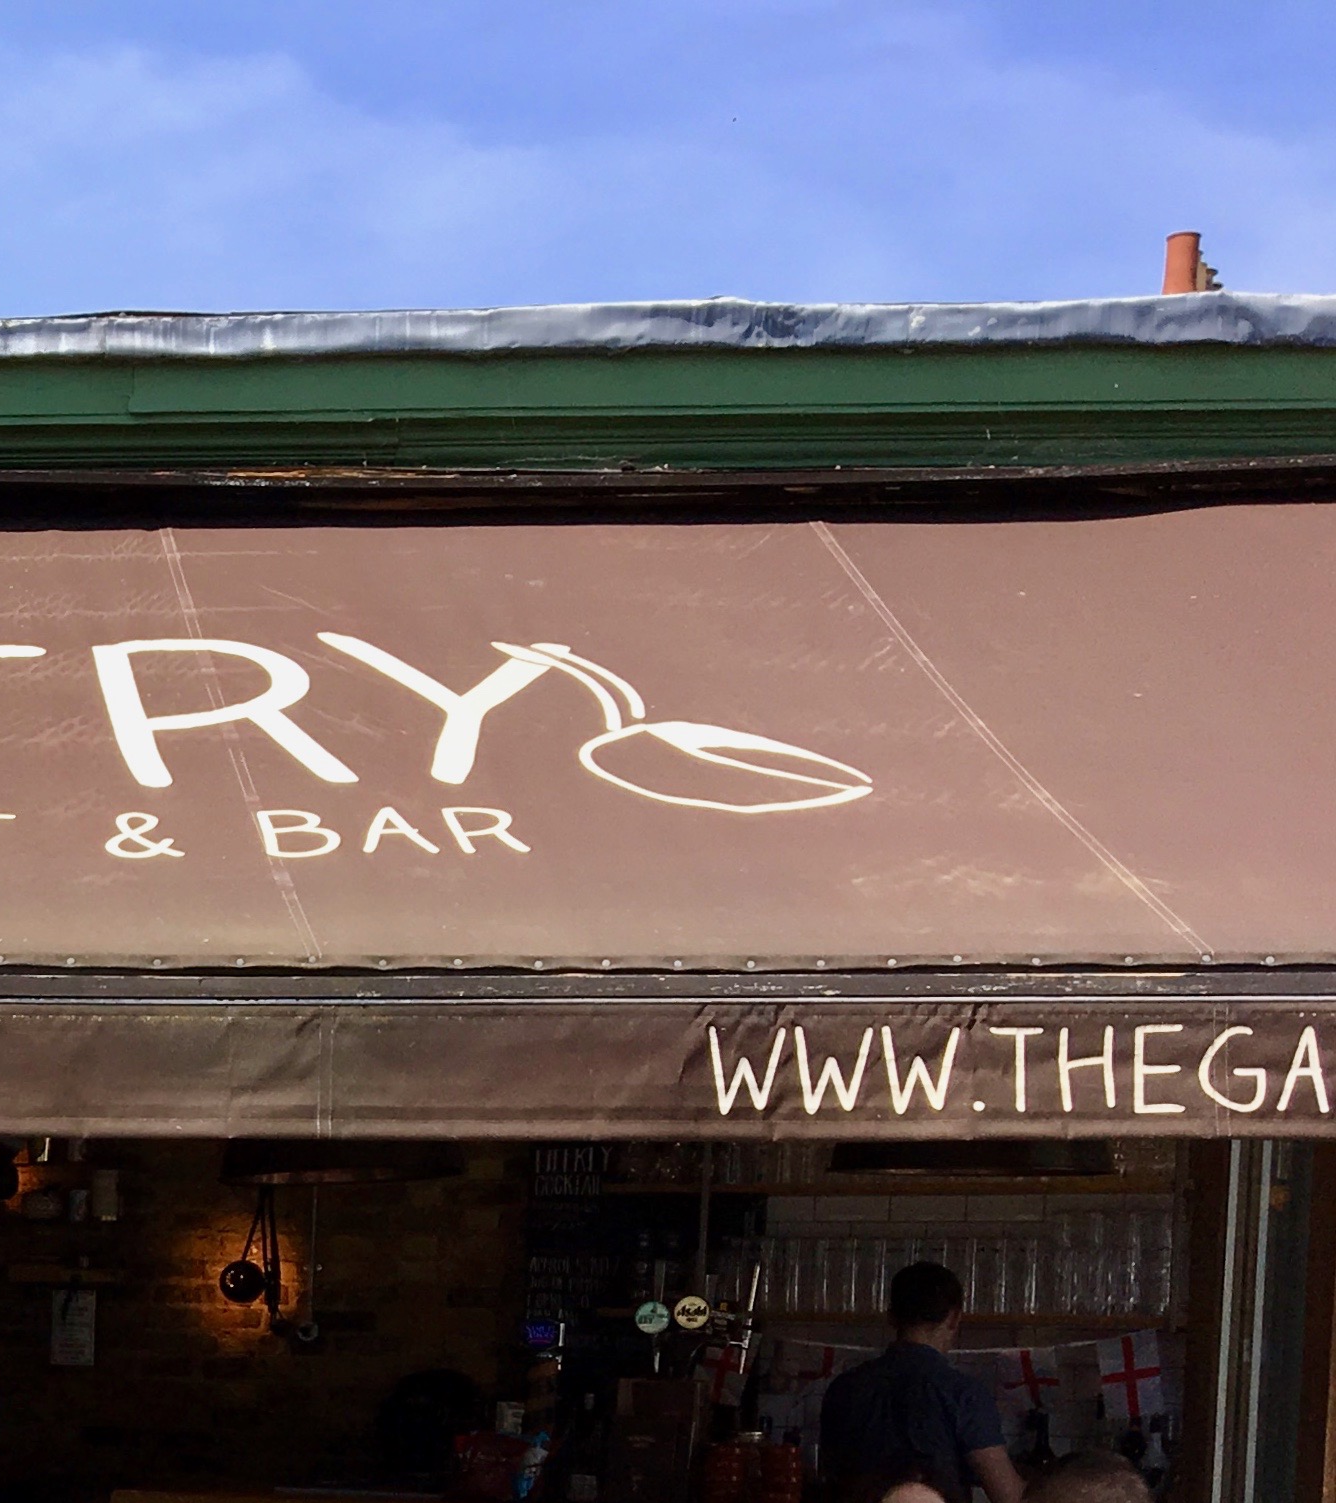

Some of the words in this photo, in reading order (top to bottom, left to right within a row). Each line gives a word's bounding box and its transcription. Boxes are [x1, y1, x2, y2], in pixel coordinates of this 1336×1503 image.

[104, 812, 185, 859] &
[256, 806, 531, 858] BAR
[709, 1023, 1330, 1116] WWW.THEGA
